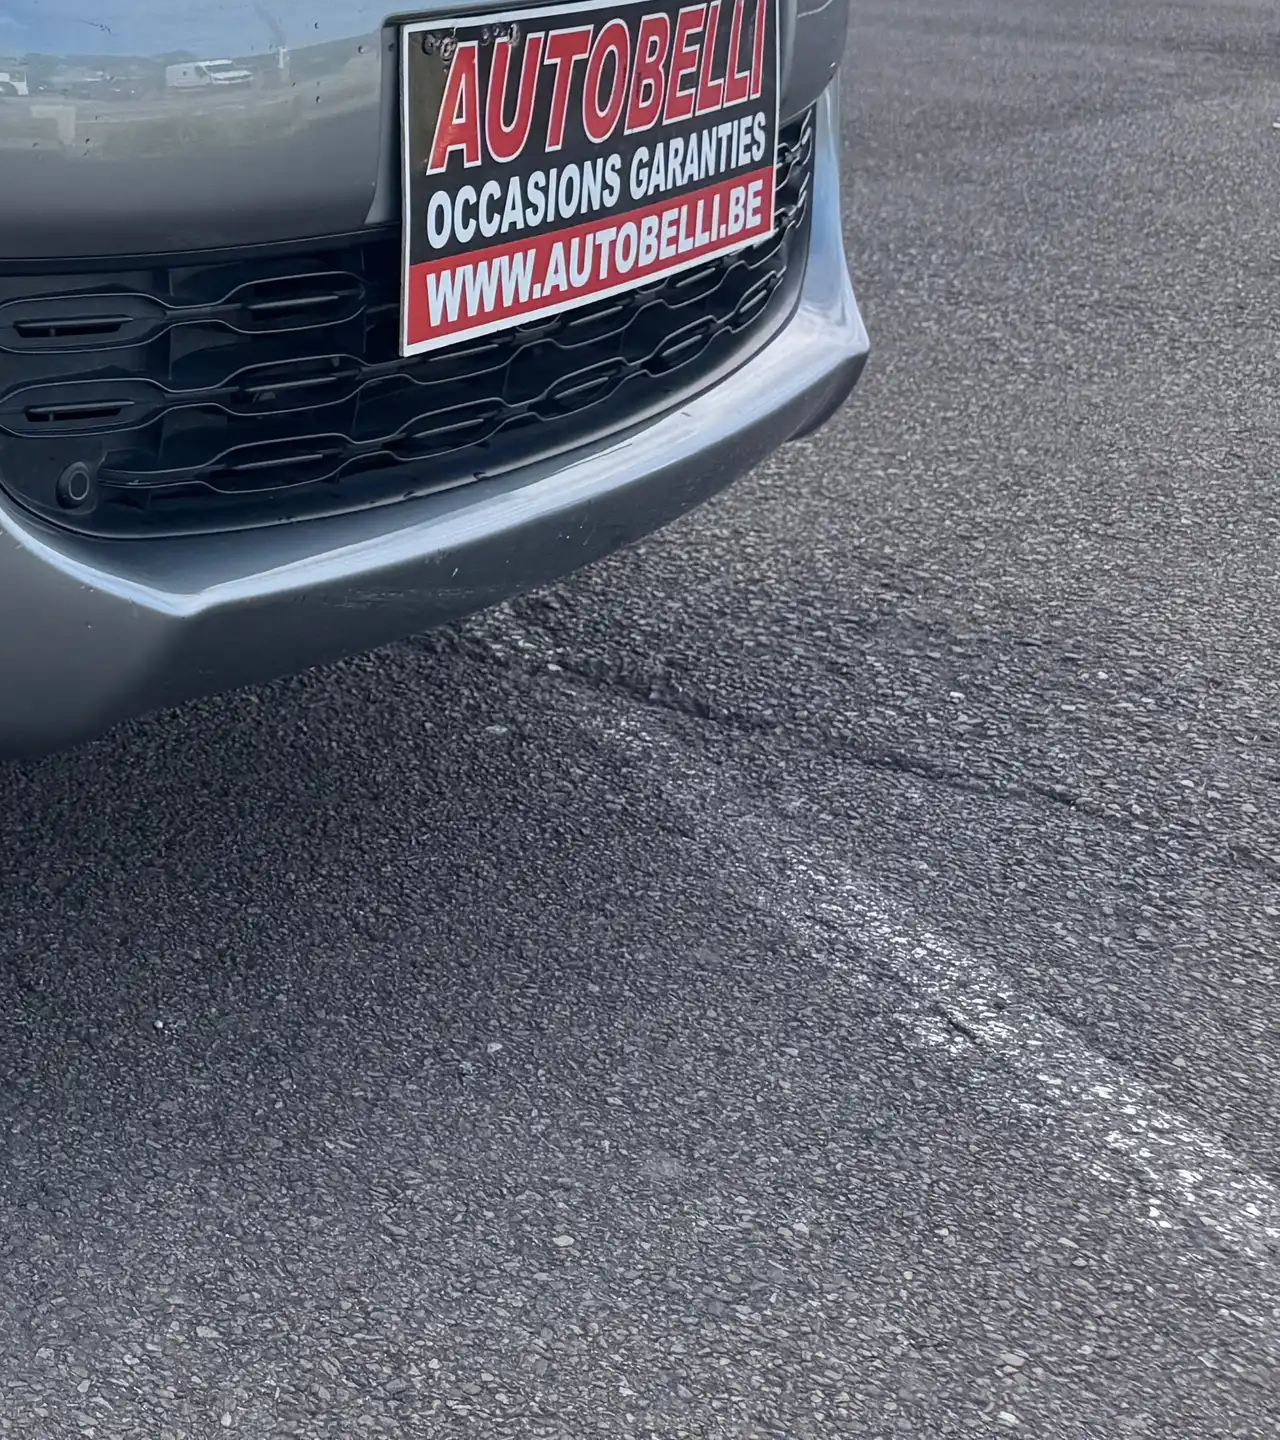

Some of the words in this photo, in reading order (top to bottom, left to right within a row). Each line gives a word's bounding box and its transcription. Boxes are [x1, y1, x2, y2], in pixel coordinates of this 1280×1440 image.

[426, 153, 621, 249] OCCASIONS
[629, 111, 767, 200] GARANTIES
[426, 179, 764, 328] WWW.AUTOBELLI.BE
